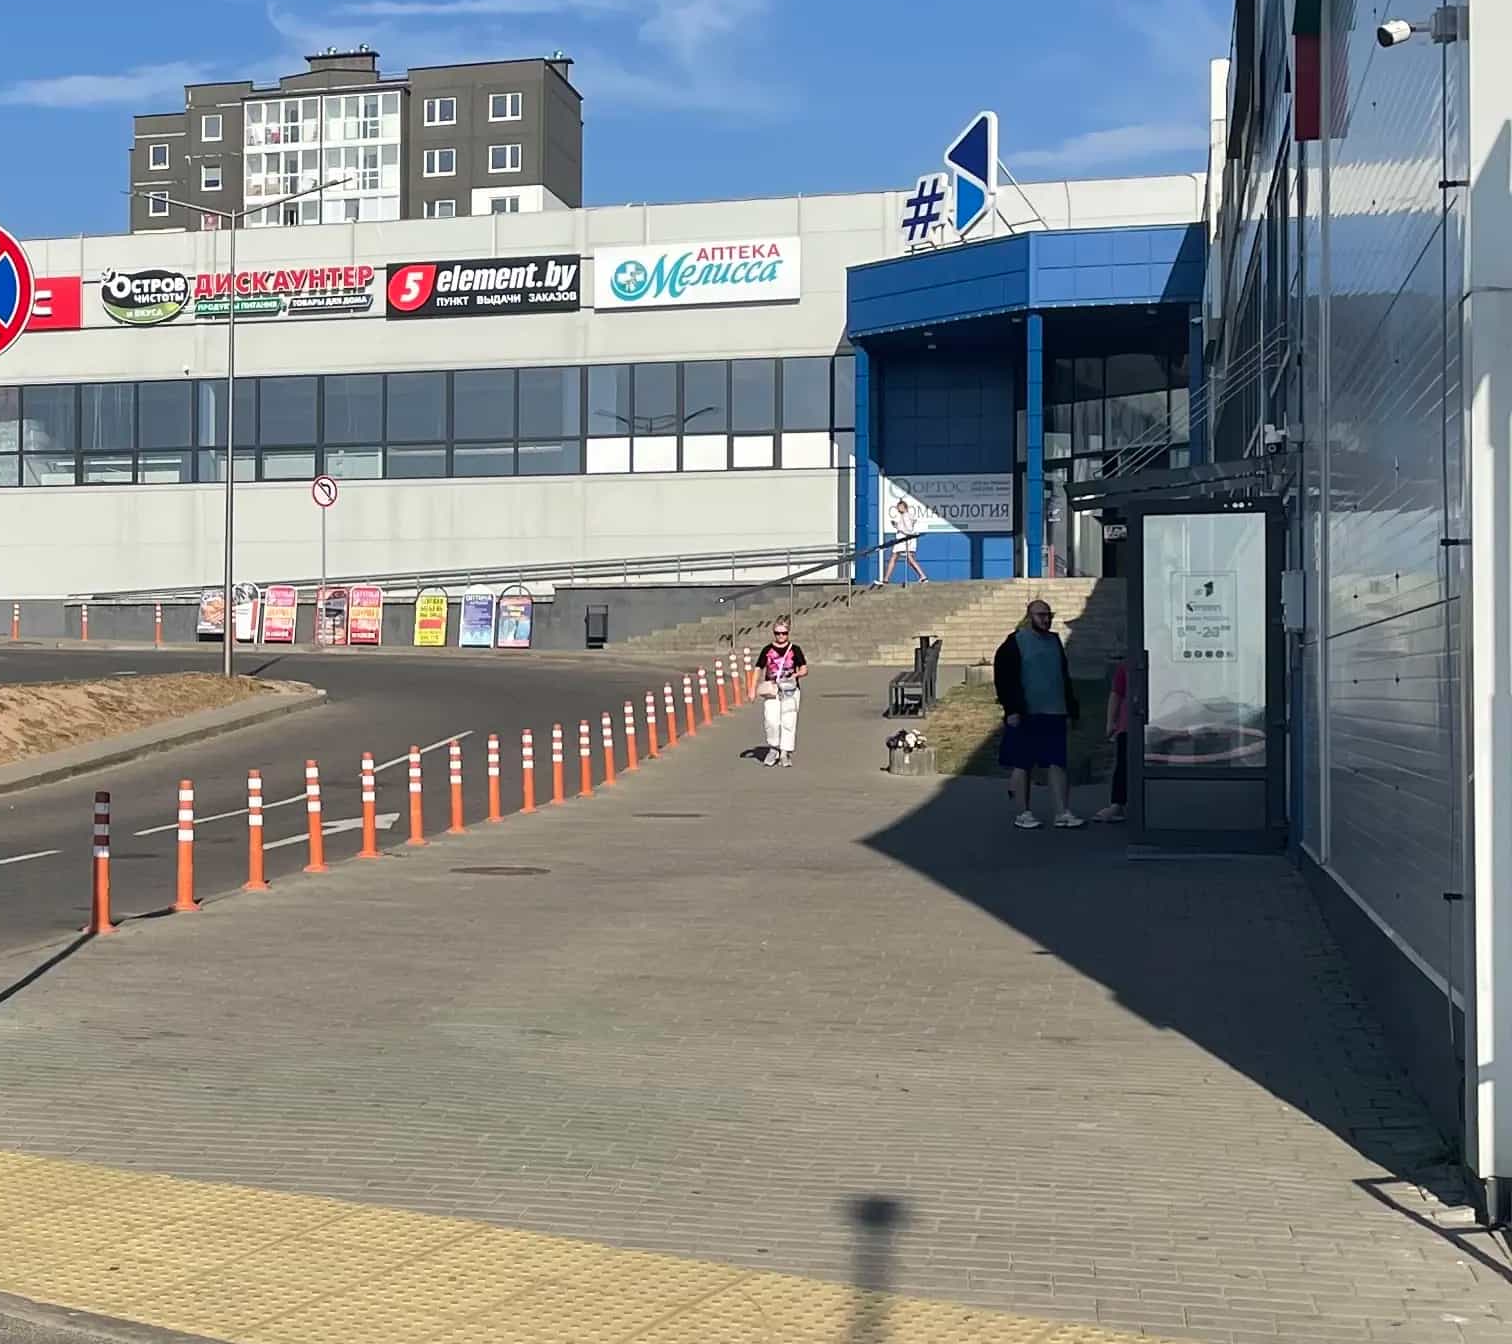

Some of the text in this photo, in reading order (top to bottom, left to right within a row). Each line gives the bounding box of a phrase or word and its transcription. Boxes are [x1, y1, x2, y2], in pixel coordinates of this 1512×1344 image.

[695, 243, 781, 262] АПТЕКА
[194, 265, 375, 298] ДИСКАУНТЕР
[400, 259, 577, 303] 5 element.by
[645, 252, 784, 298] Мелисса
[198, 302, 240, 312] ПРОДУКЫ
[436, 291, 577, 307] ПУНКТ ВЫДАЧИ ЗАКАЗОВ
[888, 503, 1010, 519] СОМАТОЛОГИЯ
